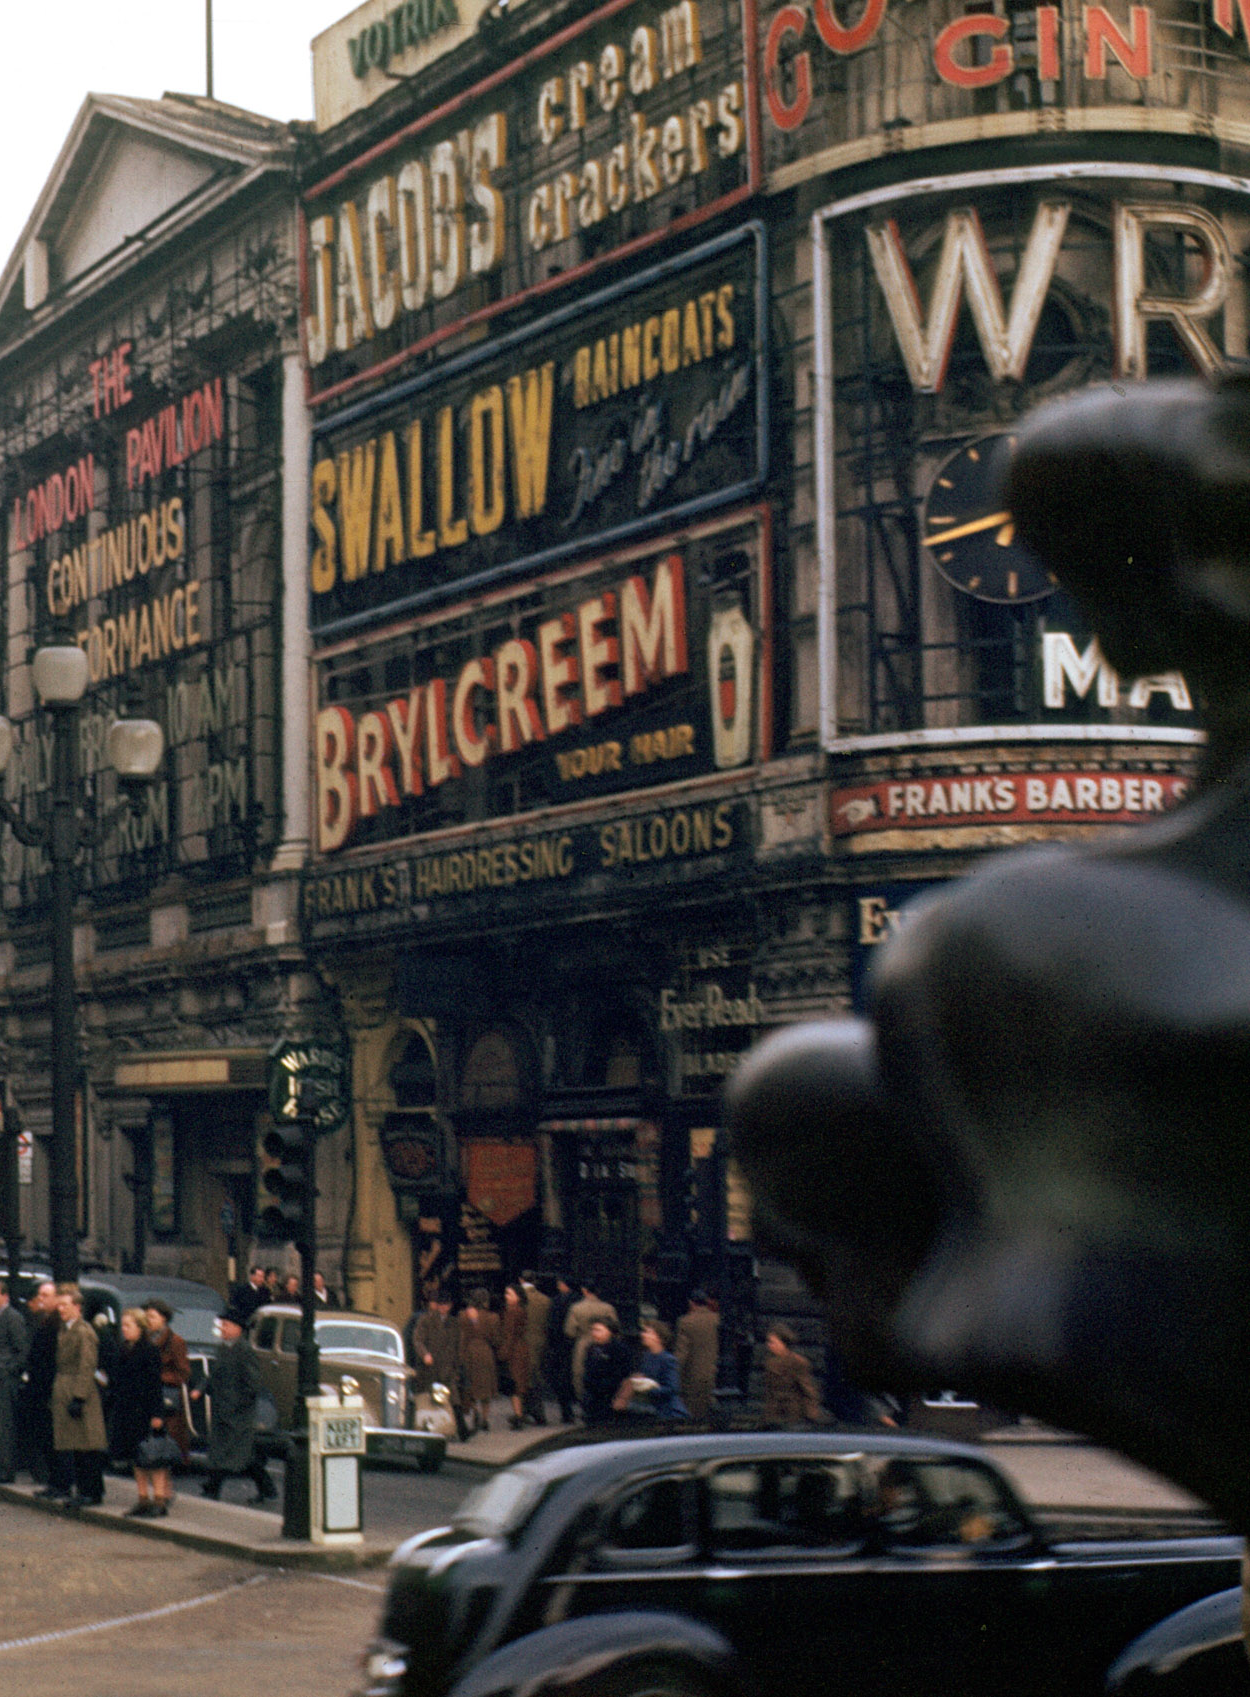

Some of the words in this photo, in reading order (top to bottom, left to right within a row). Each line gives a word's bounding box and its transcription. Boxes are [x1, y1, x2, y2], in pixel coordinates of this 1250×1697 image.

[538, 0, 703, 145] cream
[933, 5, 1151, 88] GIN
[528, 82, 746, 251] crackers
[306, 112, 507, 367] JACOB'S
[88, 342, 133, 420] THE
[574, 284, 733, 408] RAINCOATS
[14, 453, 95, 549] LONDON
[126, 377, 223, 490] PAVILION
[309, 361, 555, 594] SWALLOW
[47, 497, 184, 616] CONTINUOUS
[317, 555, 688, 853] BRYLCREEM
[555, 740, 623, 781] YOUR
[630, 724, 696, 765] HAIR
[887, 776, 1017, 818] FRANK'S
[1026, 777, 1165, 812] BARBER
[304, 869, 397, 919] FRANK'S
[415, 837, 575, 898] HAIRDRESSING
[600, 804, 733, 867] SALOONS
